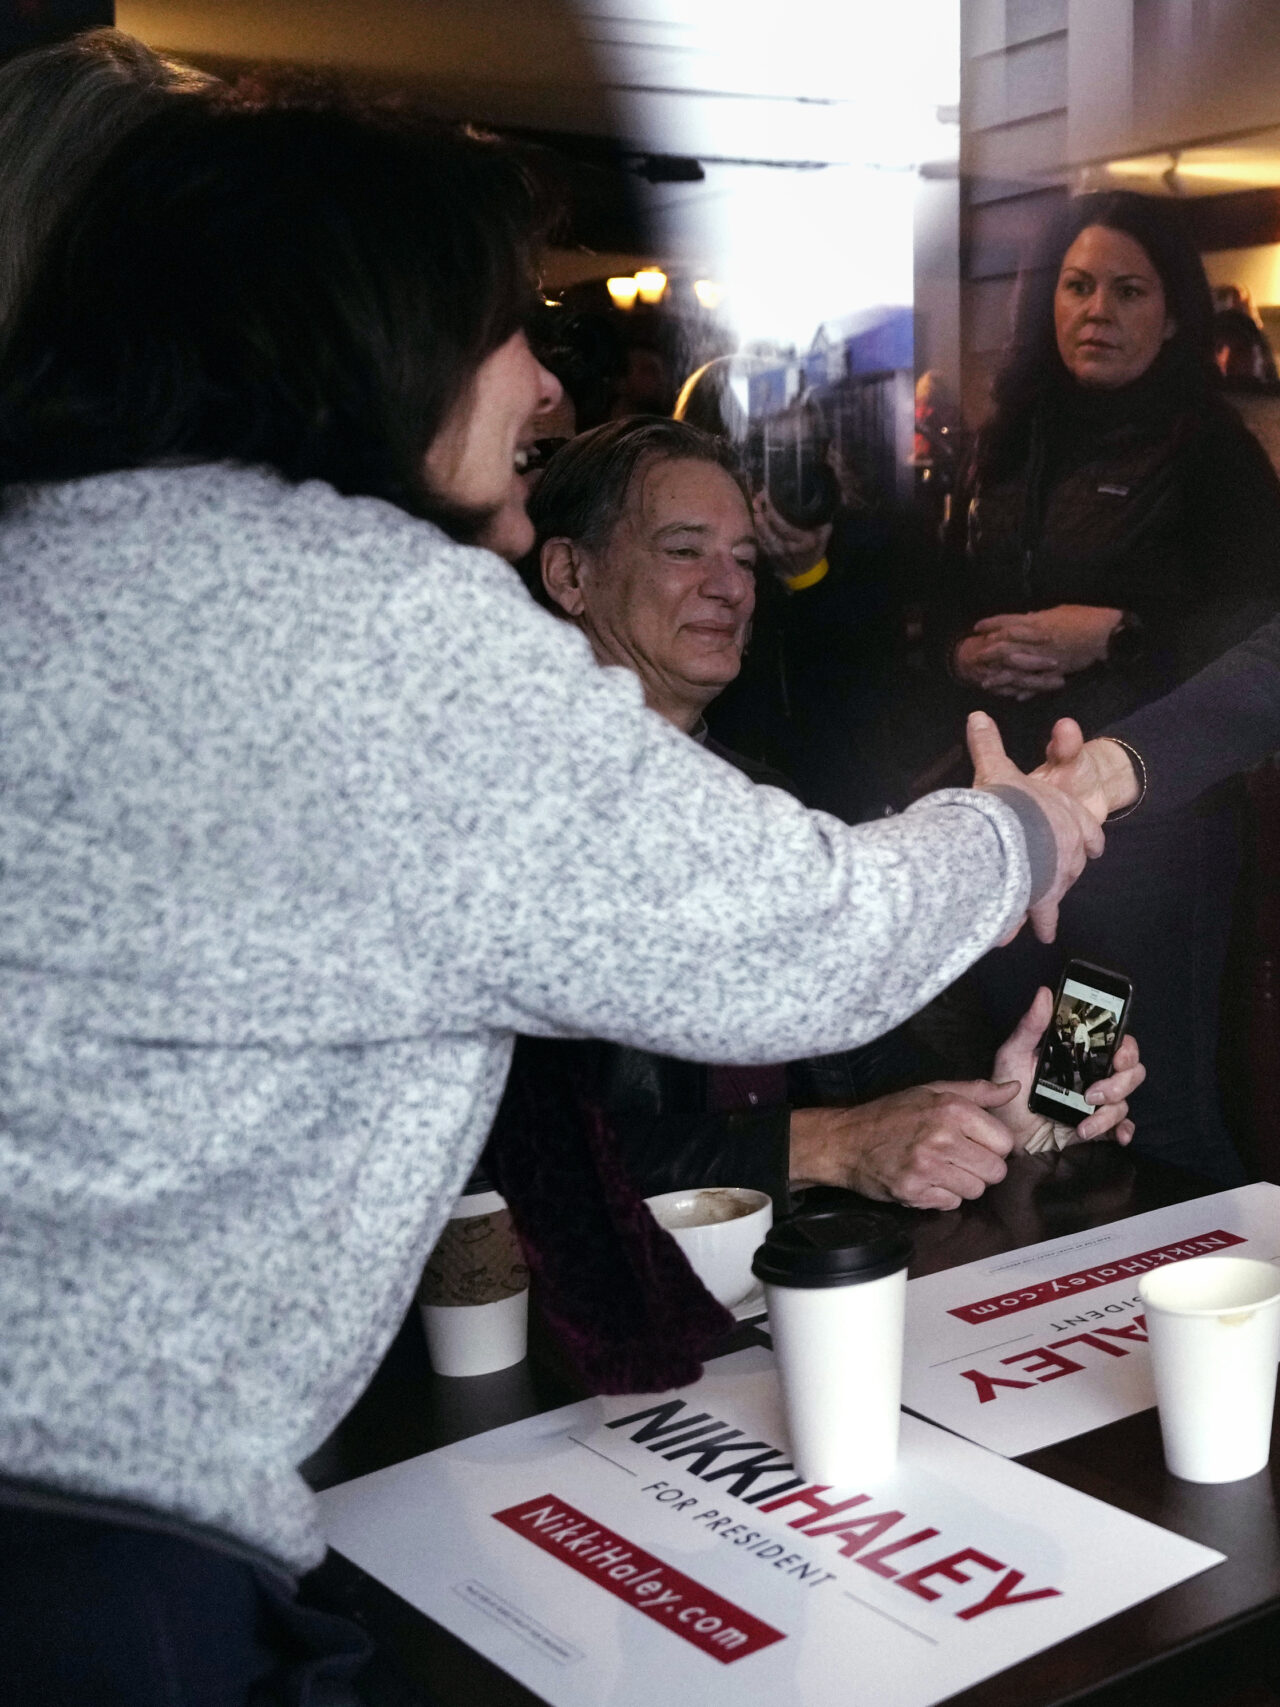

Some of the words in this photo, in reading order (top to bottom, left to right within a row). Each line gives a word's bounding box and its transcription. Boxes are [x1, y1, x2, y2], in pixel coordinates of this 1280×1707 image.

[970, 1236, 1227, 1316] NikkiHaley.com
[959, 1314, 1149, 1404] ALEY
[604, 1399, 807, 1505] NIKKI
[757, 1484, 1064, 1621] HALEY
[641, 1481, 698, 1512] FOR
[692, 1509, 837, 1588] PRESIDENT
[519, 1504, 749, 1651] NikkiHaley.com
